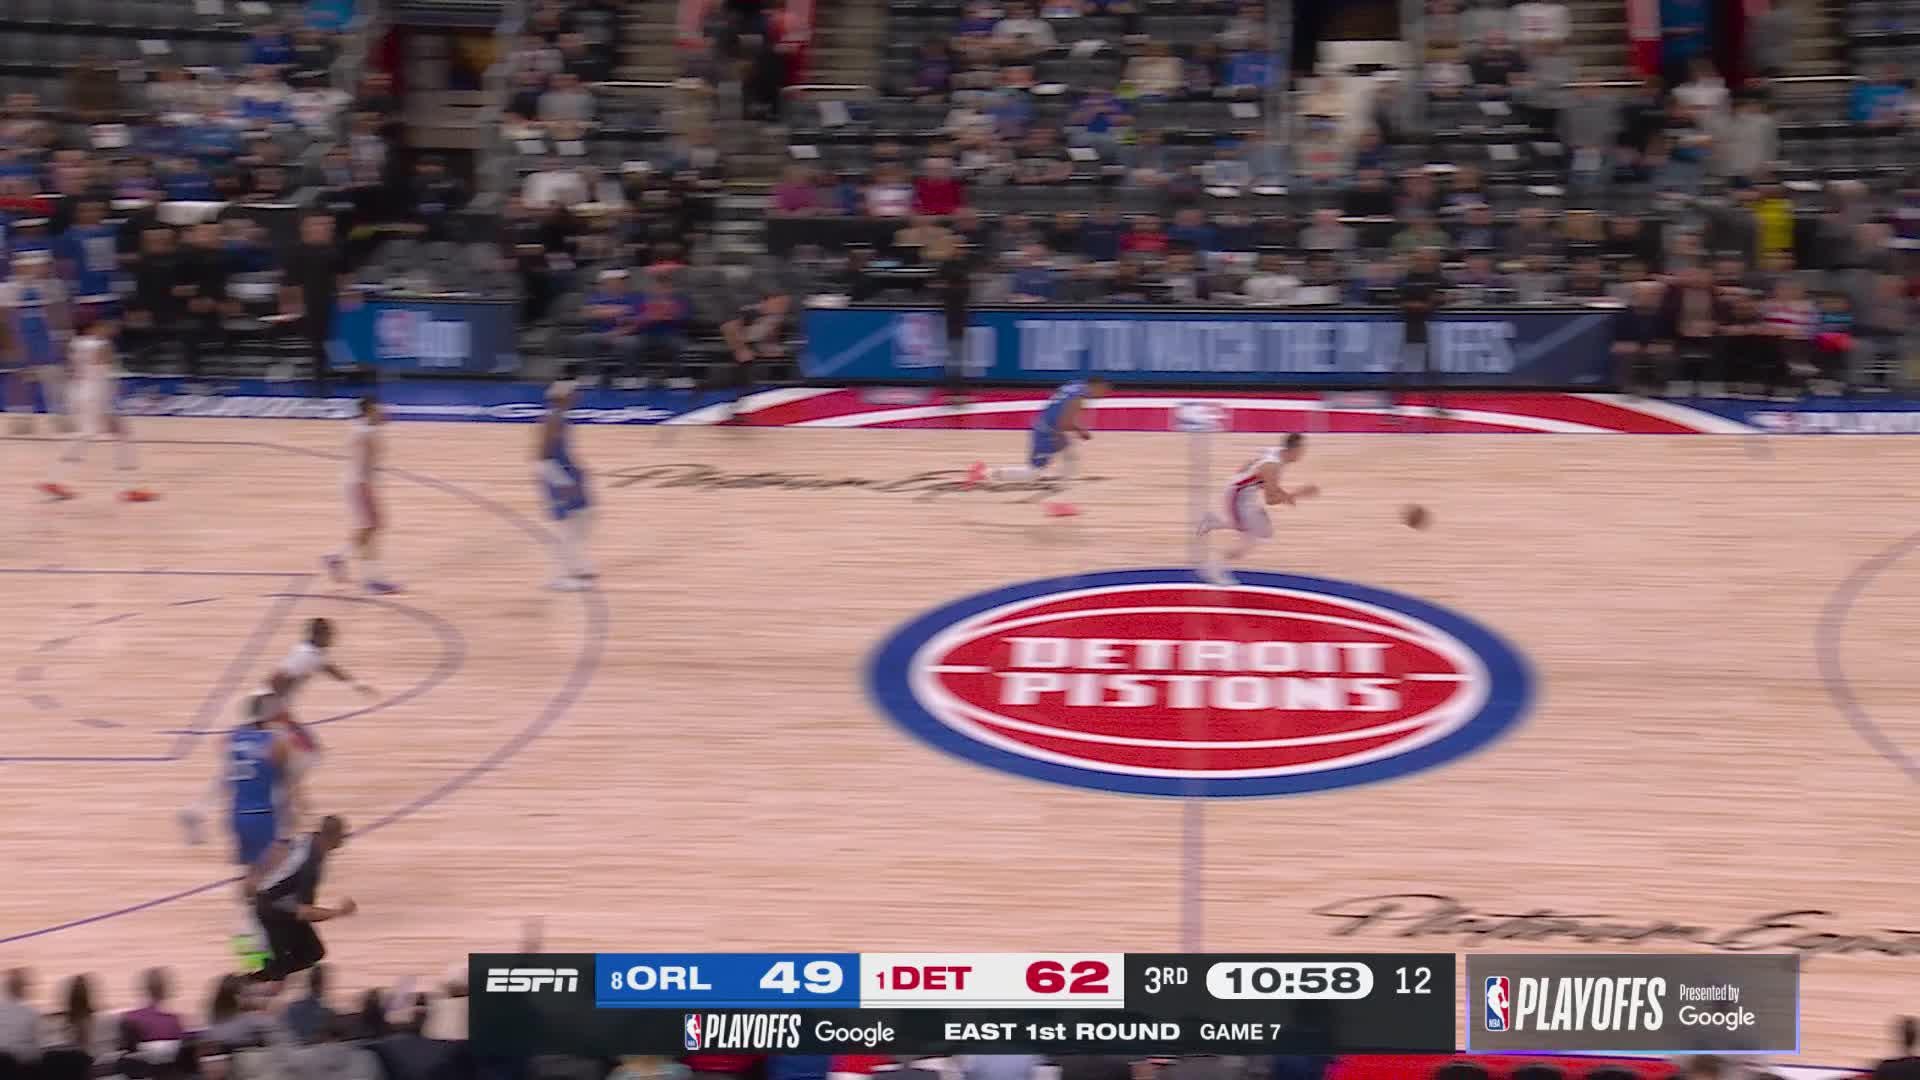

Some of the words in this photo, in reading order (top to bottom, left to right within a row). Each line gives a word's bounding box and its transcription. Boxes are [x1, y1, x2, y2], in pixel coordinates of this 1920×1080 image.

[1340, 321, 1516, 373] PLAFFS
[1004, 637, 1395, 673] DETROIT
[996, 672, 1400, 711] PISTONS
